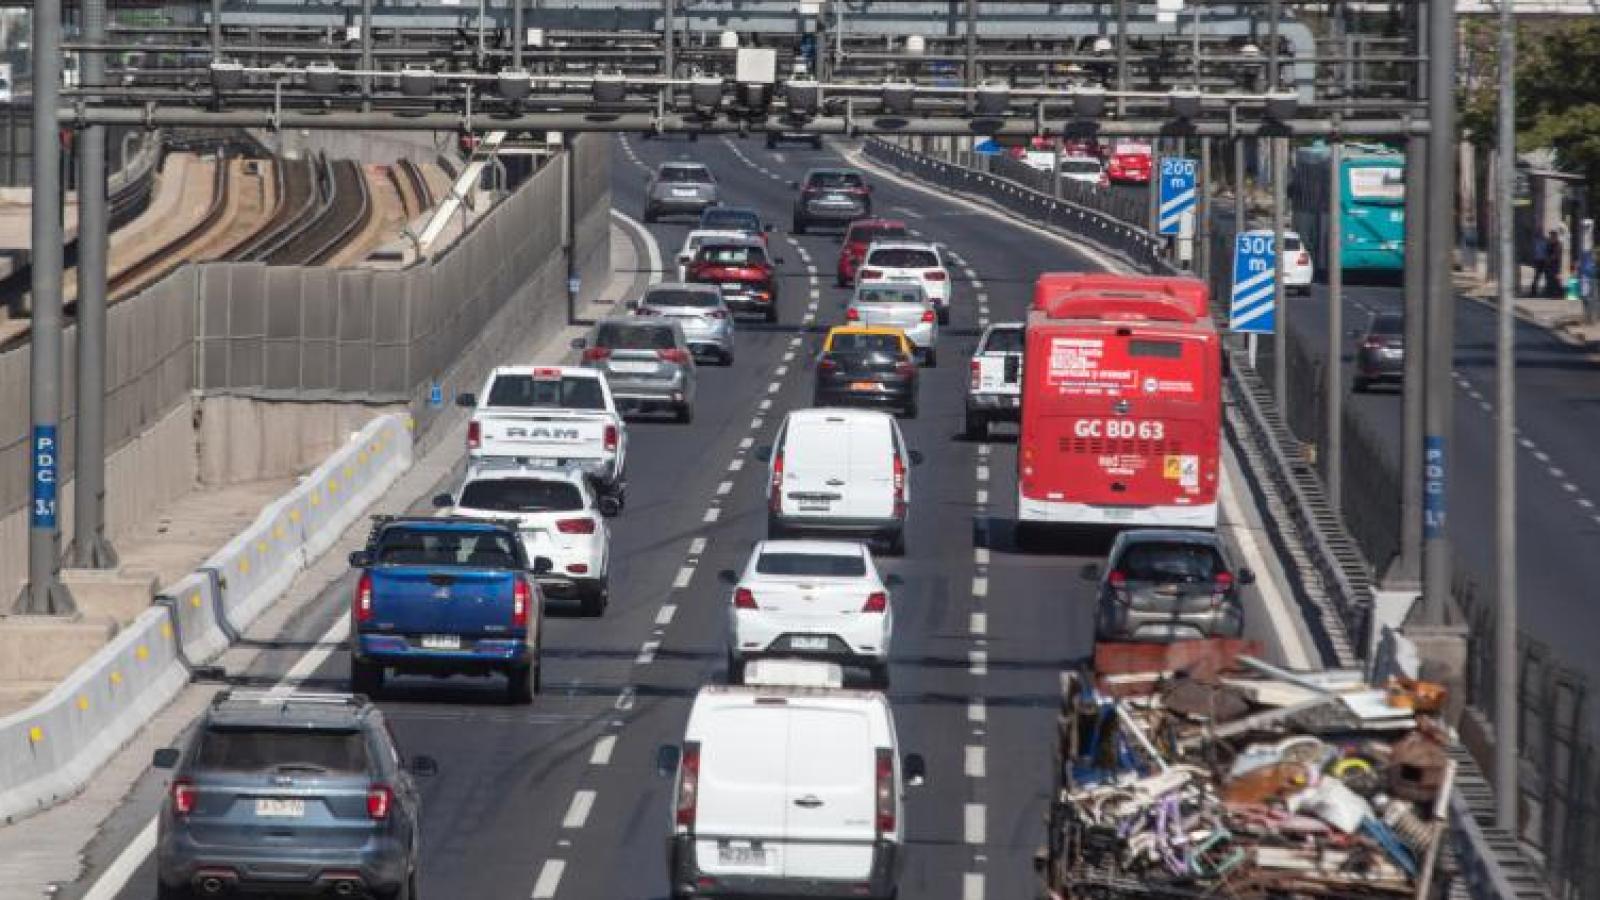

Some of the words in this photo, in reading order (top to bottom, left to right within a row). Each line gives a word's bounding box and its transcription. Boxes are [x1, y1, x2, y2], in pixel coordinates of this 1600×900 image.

[1162, 161, 1195, 175] 200
[1170, 178, 1186, 188] m
[1249, 258, 1267, 271] m
[506, 426, 579, 439] RAM
[1074, 419, 1102, 438] GC
[1106, 419, 1135, 439] BD
[1139, 421, 1164, 440] 63
[37, 437, 54, 482] PDC
